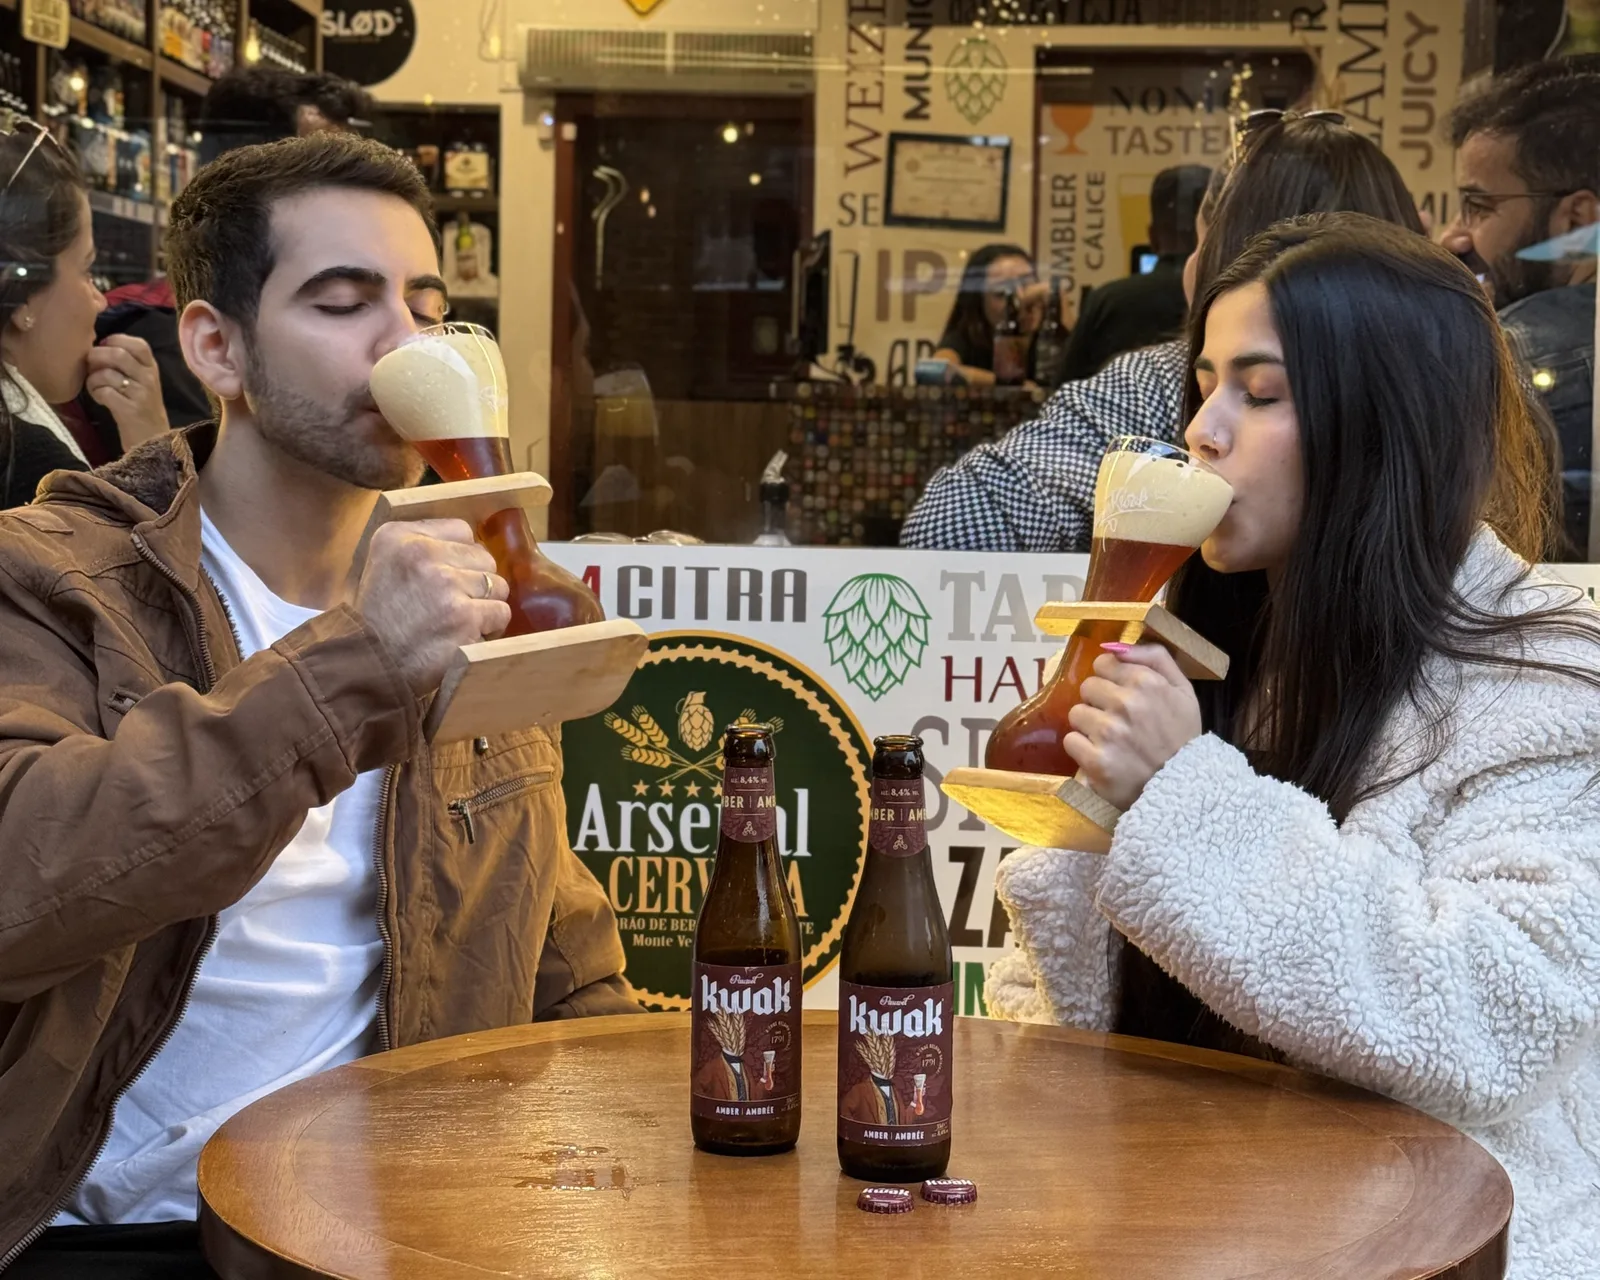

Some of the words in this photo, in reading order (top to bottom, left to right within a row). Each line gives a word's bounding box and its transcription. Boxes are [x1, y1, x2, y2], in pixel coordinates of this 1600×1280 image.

[1399, 11, 1440, 170] JUICY
[1104, 125, 1233, 156] TASTE
[1082, 170, 1106, 271] CALICE
[617, 565, 807, 623] CITRA
[740, 776, 759, 784] 8,4%
[891, 788, 911, 797] 8,4%
[649, 918, 668, 931] DE
[632, 934, 674, 947] Monte
[922, 1058, 936, 1067] 1791
[716, 1105, 739, 1116] AMBER
[745, 1105, 774, 1116] AMBRÉE
[864, 1129, 888, 1140] AMBER
[895, 1129, 925, 1140] AMBRÉE
